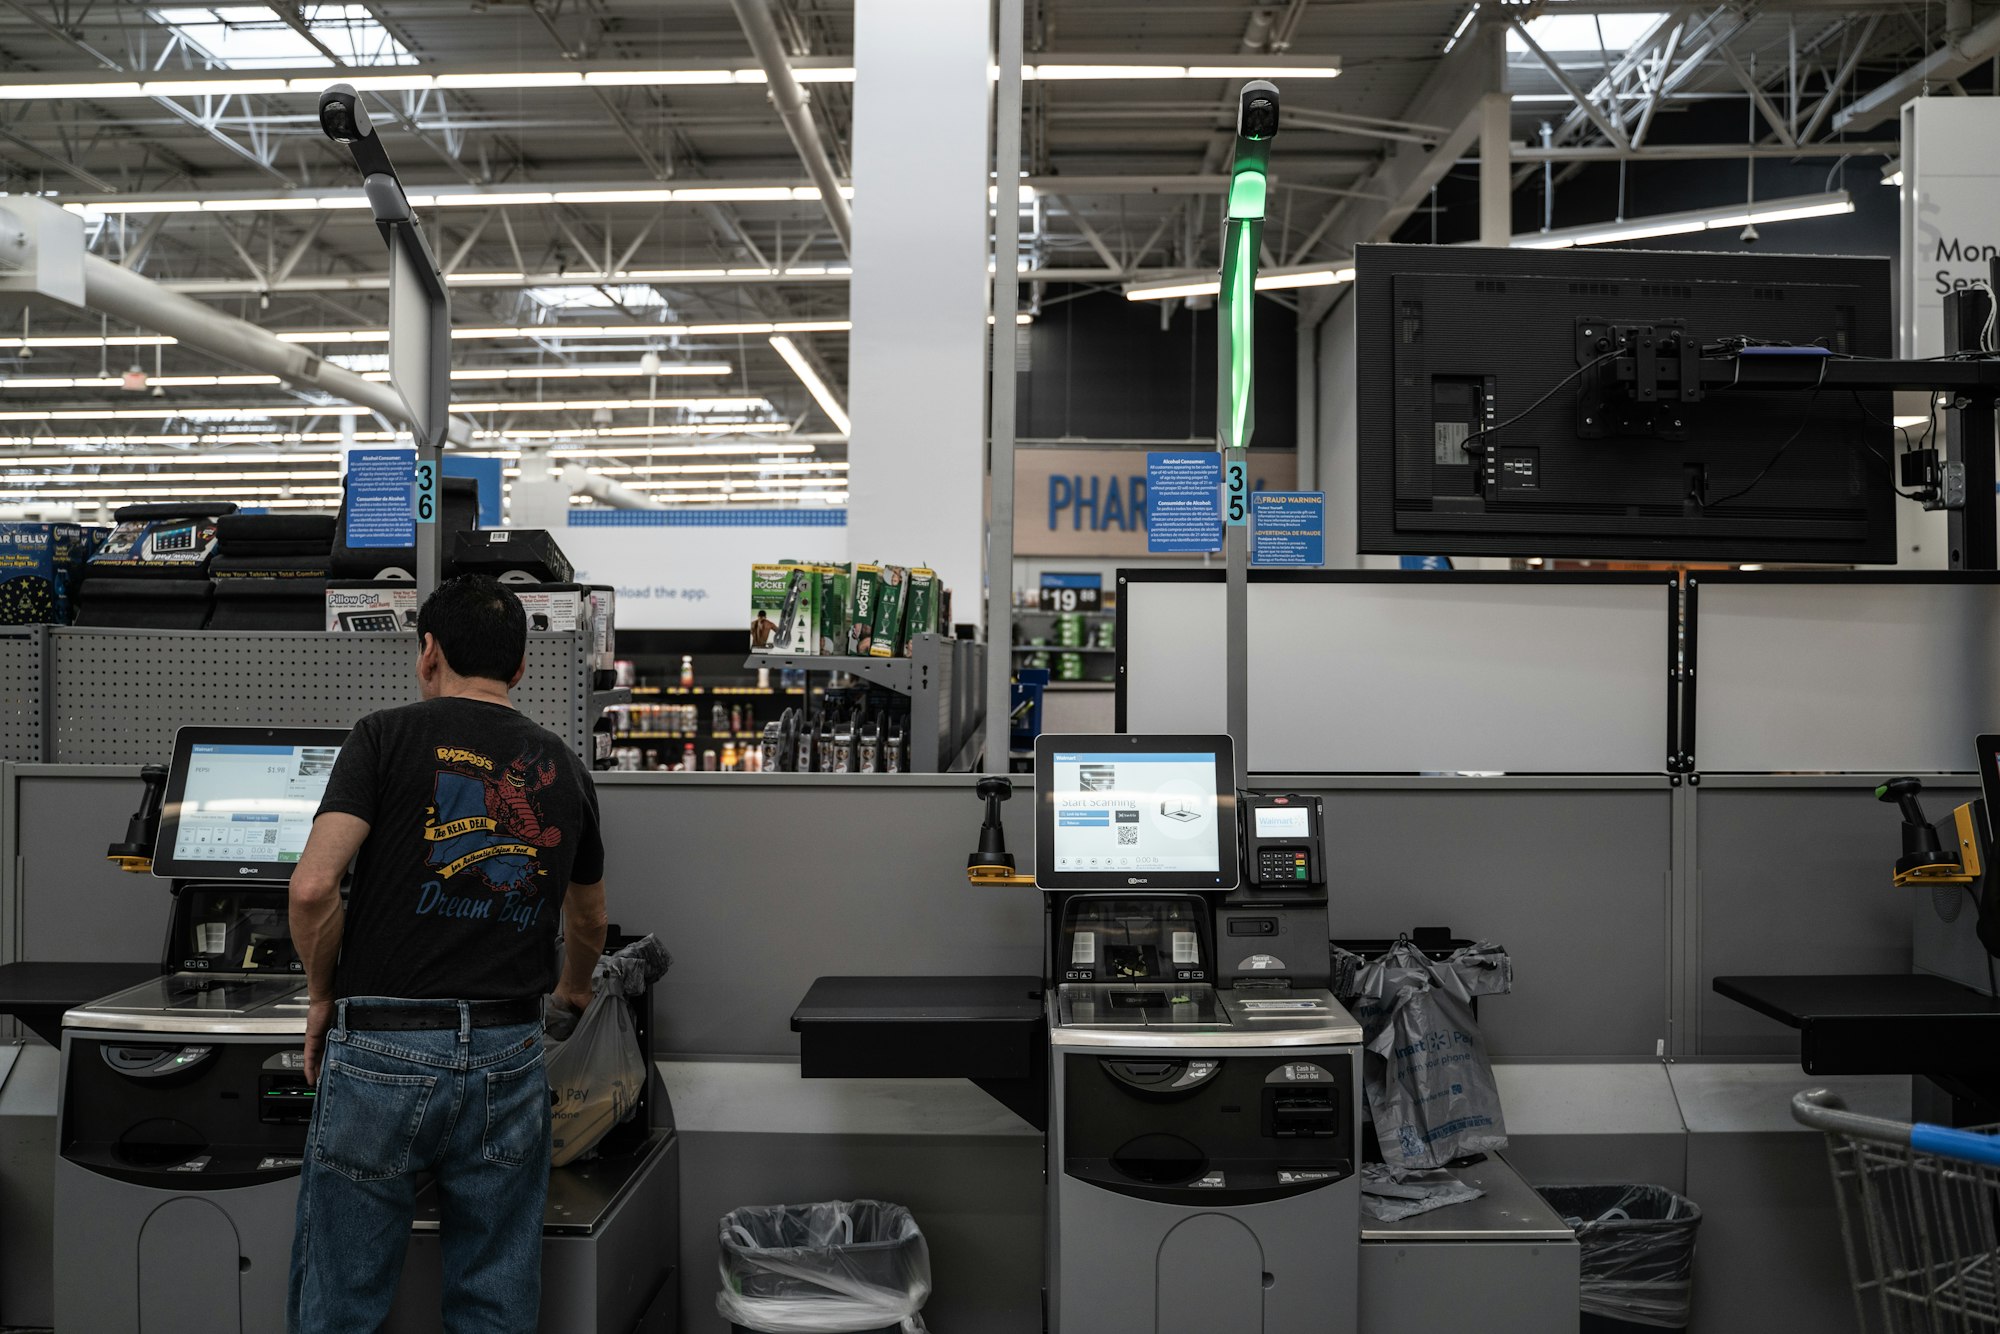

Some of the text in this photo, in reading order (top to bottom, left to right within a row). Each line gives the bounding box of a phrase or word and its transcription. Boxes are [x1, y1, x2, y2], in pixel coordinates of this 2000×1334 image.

[1935, 237, 2000, 262] Mon
[15, 535, 48, 543] BELLY
[754, 580, 786, 589] ROCKET
[329, 594, 379, 604] Pillow Pad
[655, 586, 677, 598] the
[680, 588, 709, 602] app.
[858, 579, 871, 617] ROCKET
[1050, 588, 1077, 611] 19
[1062, 798, 1136, 809] Start Scanning
[433, 818, 488, 839] The REAL DEAL
[1260, 816, 1292, 825] Walmart
[463, 851, 490, 864] Authentic
[492, 847, 510, 857] Cajun
[415, 880, 545, 932] Dream Big!
[1426, 1053, 1470, 1069] your phone
[567, 1088, 588, 1103] Pay
